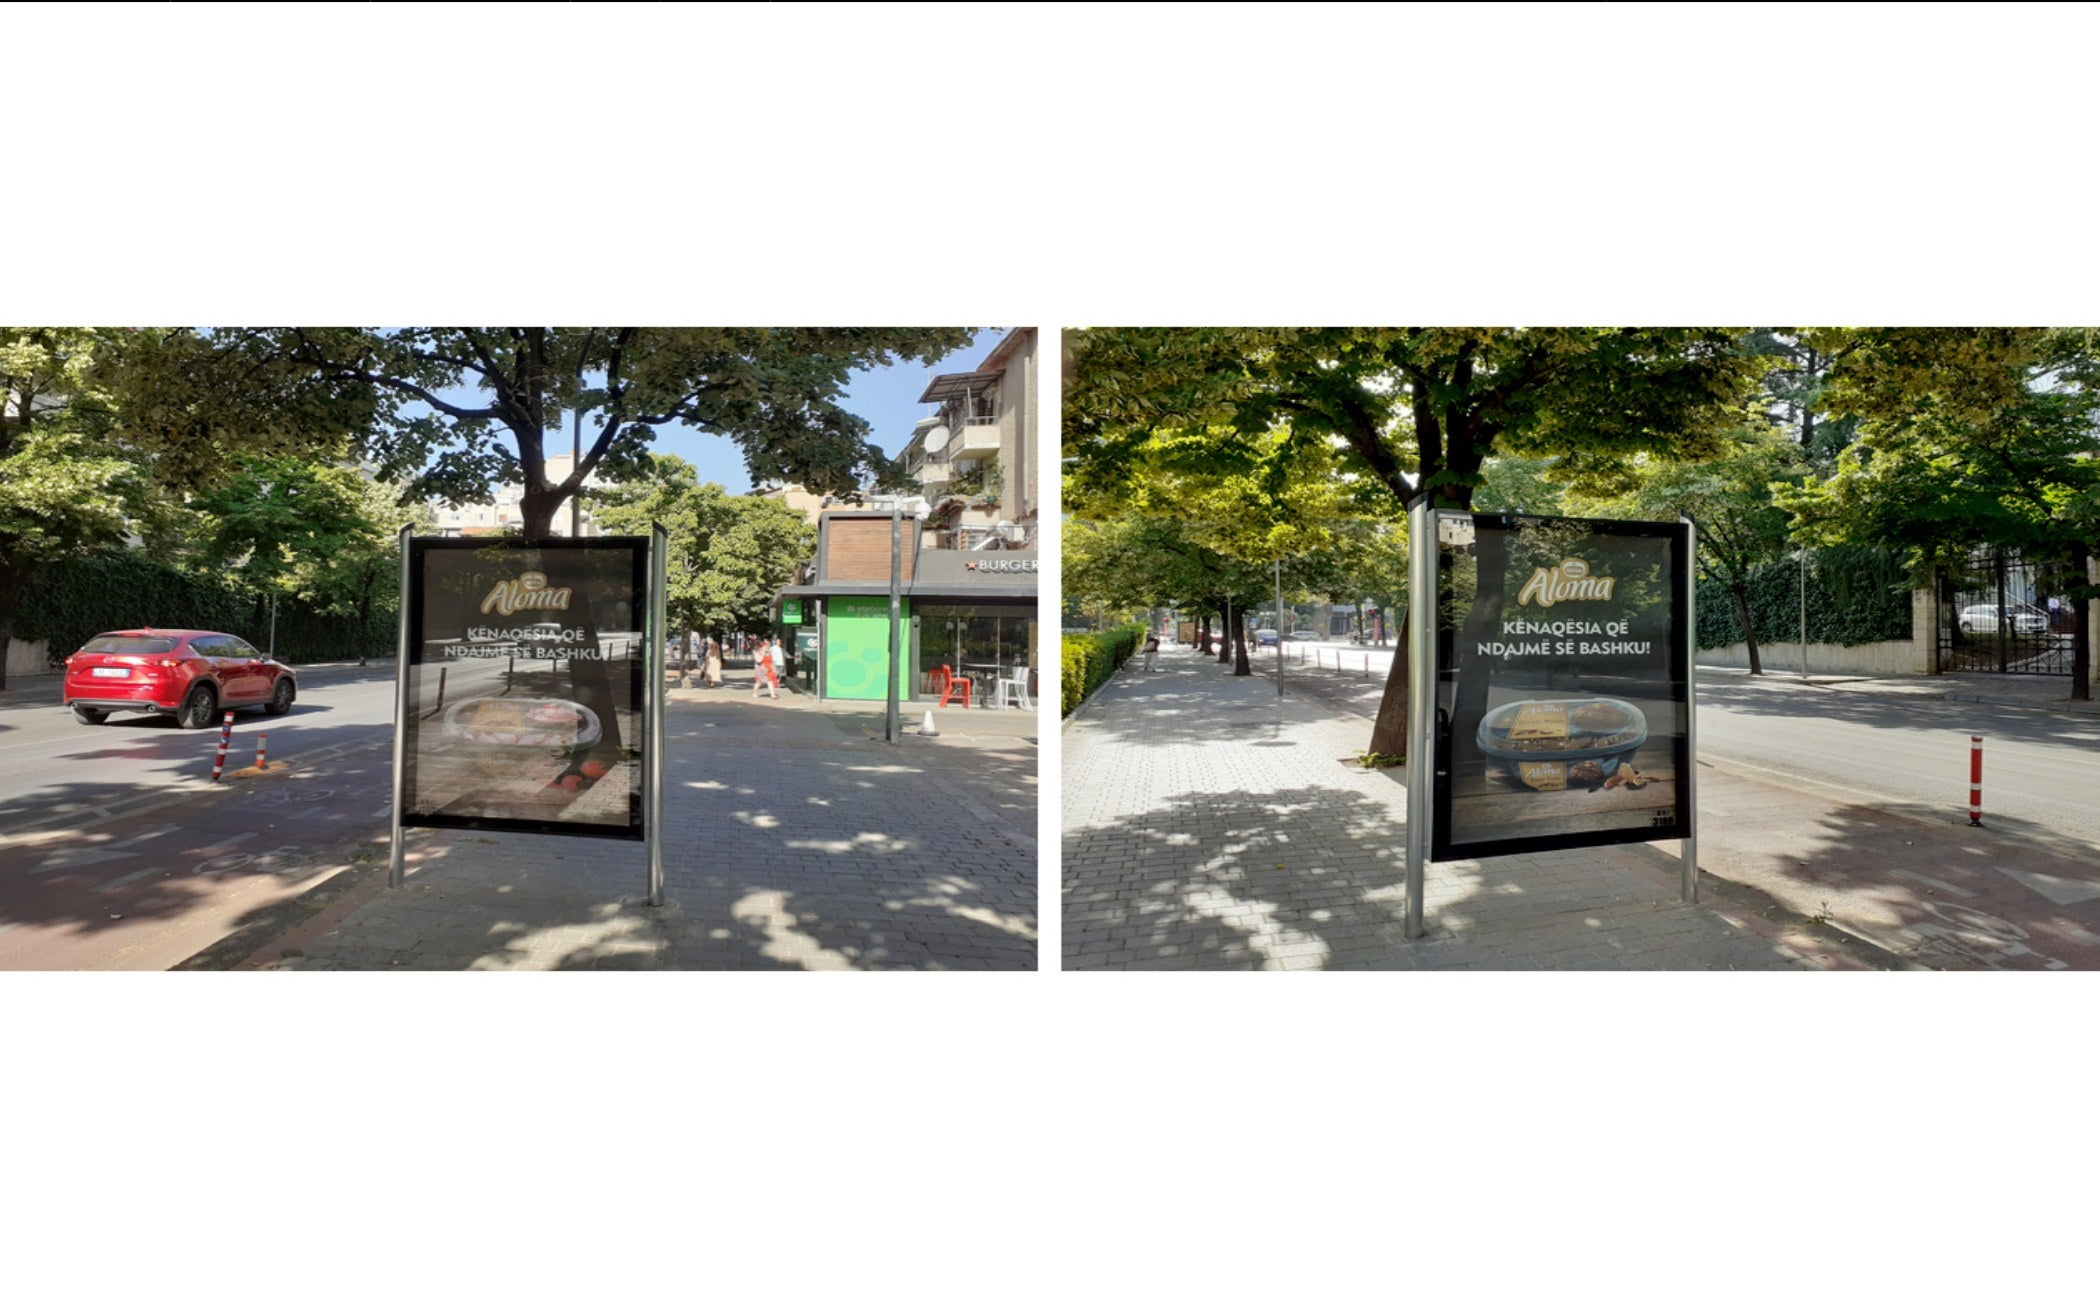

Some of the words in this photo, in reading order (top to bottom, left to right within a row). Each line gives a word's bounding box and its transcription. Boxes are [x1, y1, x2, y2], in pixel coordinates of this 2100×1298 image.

[483, 579, 571, 614] Aloma
[1520, 566, 1613, 606] Aloma
[561, 626, 586, 644] QË
[1503, 617, 1602, 637] KËNAQËSIA
[1605, 617, 1630, 638] QË
[1477, 638, 1551, 656] NDAJMË
[1555, 638, 1576, 655] SË
[1579, 640, 1651, 656] BASHKU!
